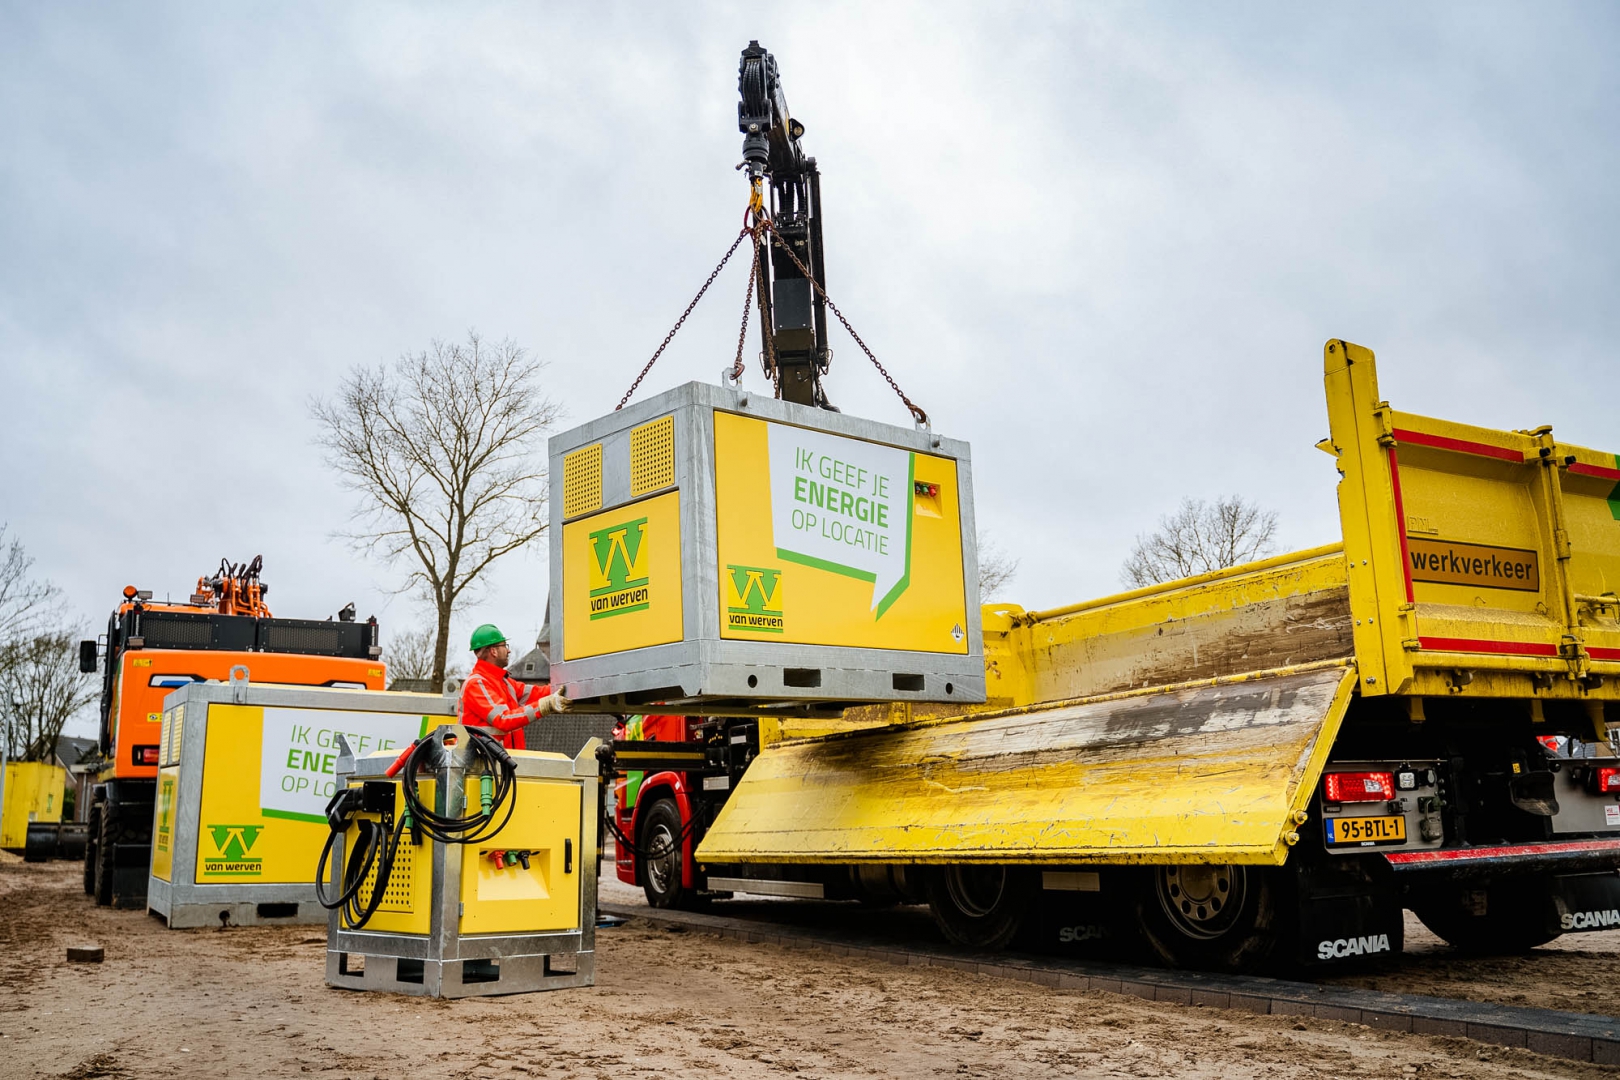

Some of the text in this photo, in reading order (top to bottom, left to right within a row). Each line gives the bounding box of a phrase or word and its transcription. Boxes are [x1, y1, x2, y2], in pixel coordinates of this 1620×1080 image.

[795, 446, 890, 499] IK GEEF JE
[794, 476, 889, 528] ENERGIE
[792, 509, 889, 556] OP LOCATIE
[1410, 550, 1532, 580] werkverkeer
[590, 588, 648, 612] van werven
[729, 614, 783, 627] van werven
[291, 724, 311, 745] IK
[316, 729, 372, 753] GEF
[281, 775, 309, 793] OP
[1341, 819, 1399, 839] 95-BTL-1
[205, 863, 262, 871] van werven
[1560, 909, 1620, 930] SCANIA
[1059, 925, 1111, 942] SCAN
[1317, 934, 1390, 959] SCANIA
